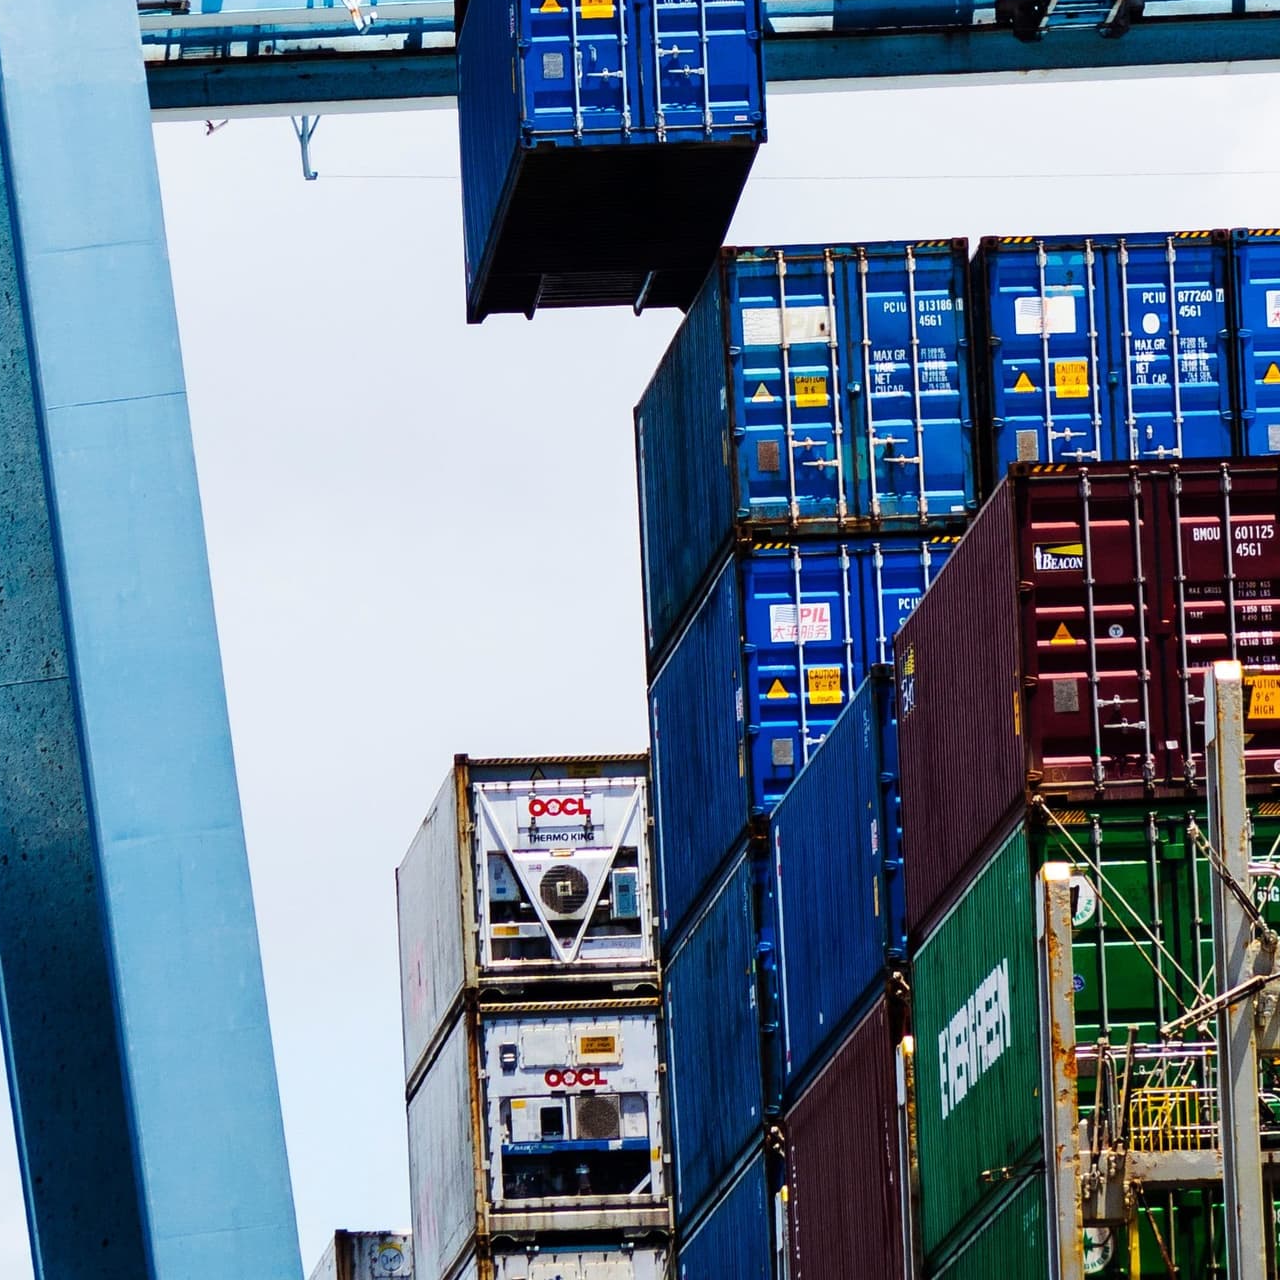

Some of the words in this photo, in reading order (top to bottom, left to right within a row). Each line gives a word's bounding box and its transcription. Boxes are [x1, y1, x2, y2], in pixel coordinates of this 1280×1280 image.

[1142, 292, 1166, 304] PCIU
[1178, 290, 1212, 303] 877260
[883, 302, 907, 313] PCIU
[1179, 305, 1201, 317] 45G1
[919, 314, 942, 326] 45G1
[1056, 365, 1086, 374] CAUTION
[1193, 527, 1221, 541] BMOU
[1235, 525, 1274, 540] 601125
[1236, 543, 1262, 556] 45G1
[800, 608, 829, 623] PIL
[809, 669, 839, 680] CAUTION
[1246, 679, 1280, 688] CAUTION
[1254, 705, 1274, 715] HIGH
[528, 798, 591, 817] OOCL
[528, 833, 569, 842] THERMO
[570, 832, 595, 841] KING
[938, 958, 1011, 1120] EVERGREEN
[545, 1067, 608, 1087] OOCL
